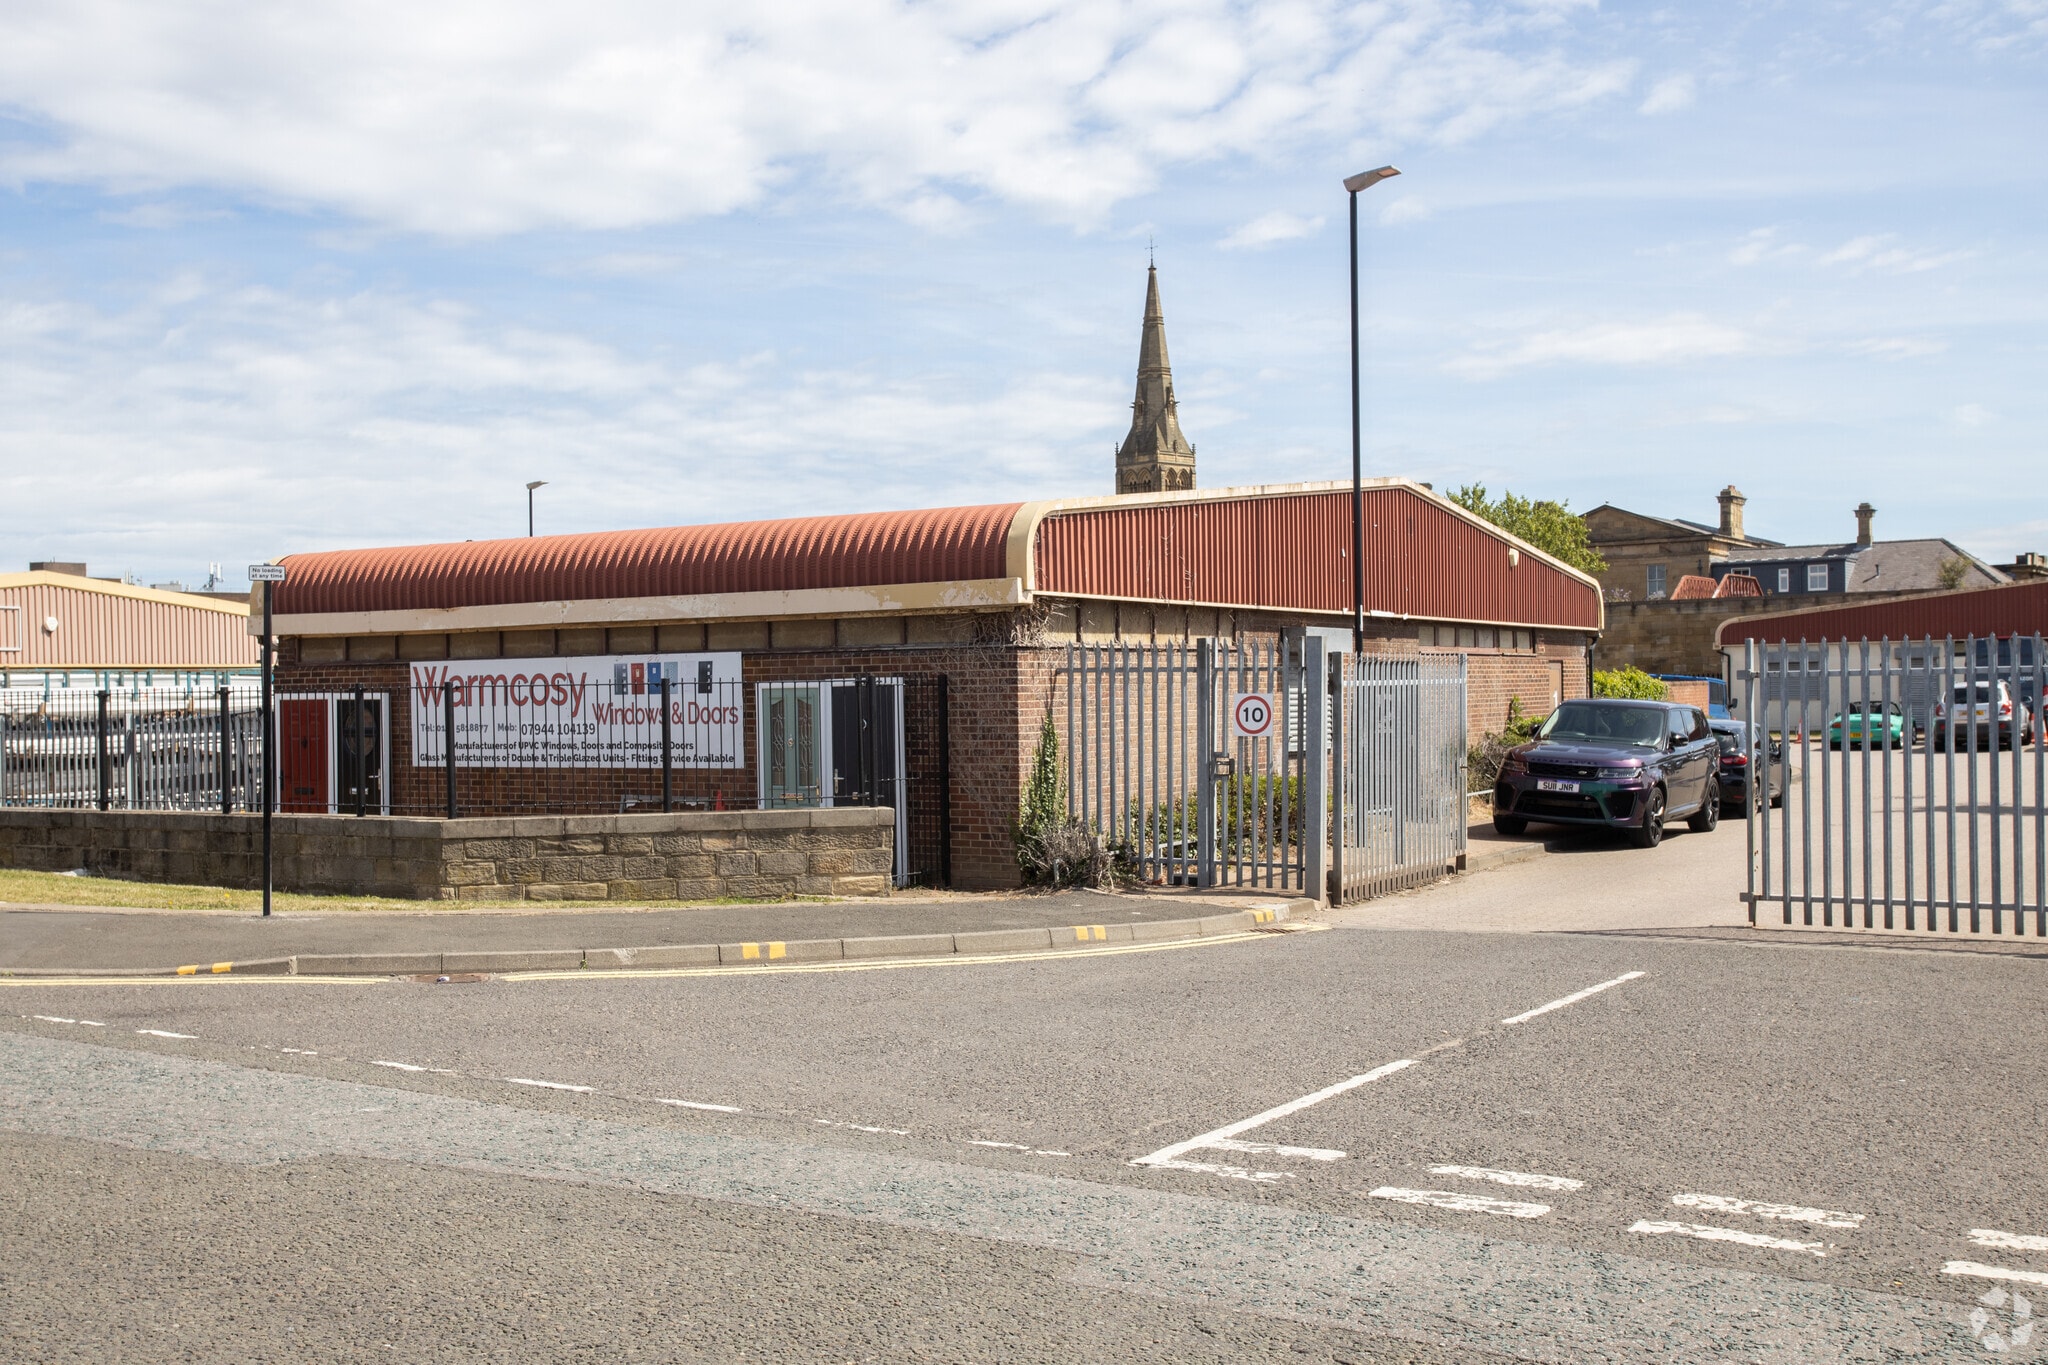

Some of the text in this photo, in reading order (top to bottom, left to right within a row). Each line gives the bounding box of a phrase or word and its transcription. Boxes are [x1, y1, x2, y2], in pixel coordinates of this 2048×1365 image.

[413, 665, 587, 718] Warmcosy
[671, 701, 684, 725] &
[688, 701, 739, 725] Doors
[1243, 707, 1264, 723] 10
[420, 723, 435, 732] Tel:
[497, 723, 517, 732] Mob:
[521, 723, 554, 736] 07944
[557, 723, 596, 736] 104139
[453, 740, 694, 752] Manufacturers of UPVC Windows, Doors and Composit Doors
[420, 753, 440, 762] Glass
[441, 753, 500, 762] Mufactureres
[502, 753, 510, 762] of
[511, 753, 539, 762] Double
[541, 753, 547, 762] &
[573, 753, 601, 762] Glazed
[603, 753, 624, 763] Units
[631, 753, 658, 765] Fitting
[660, 753, 692, 763] Srvice
[692, 753, 735, 763] Available
[1558, 783, 1574, 792] JNR
